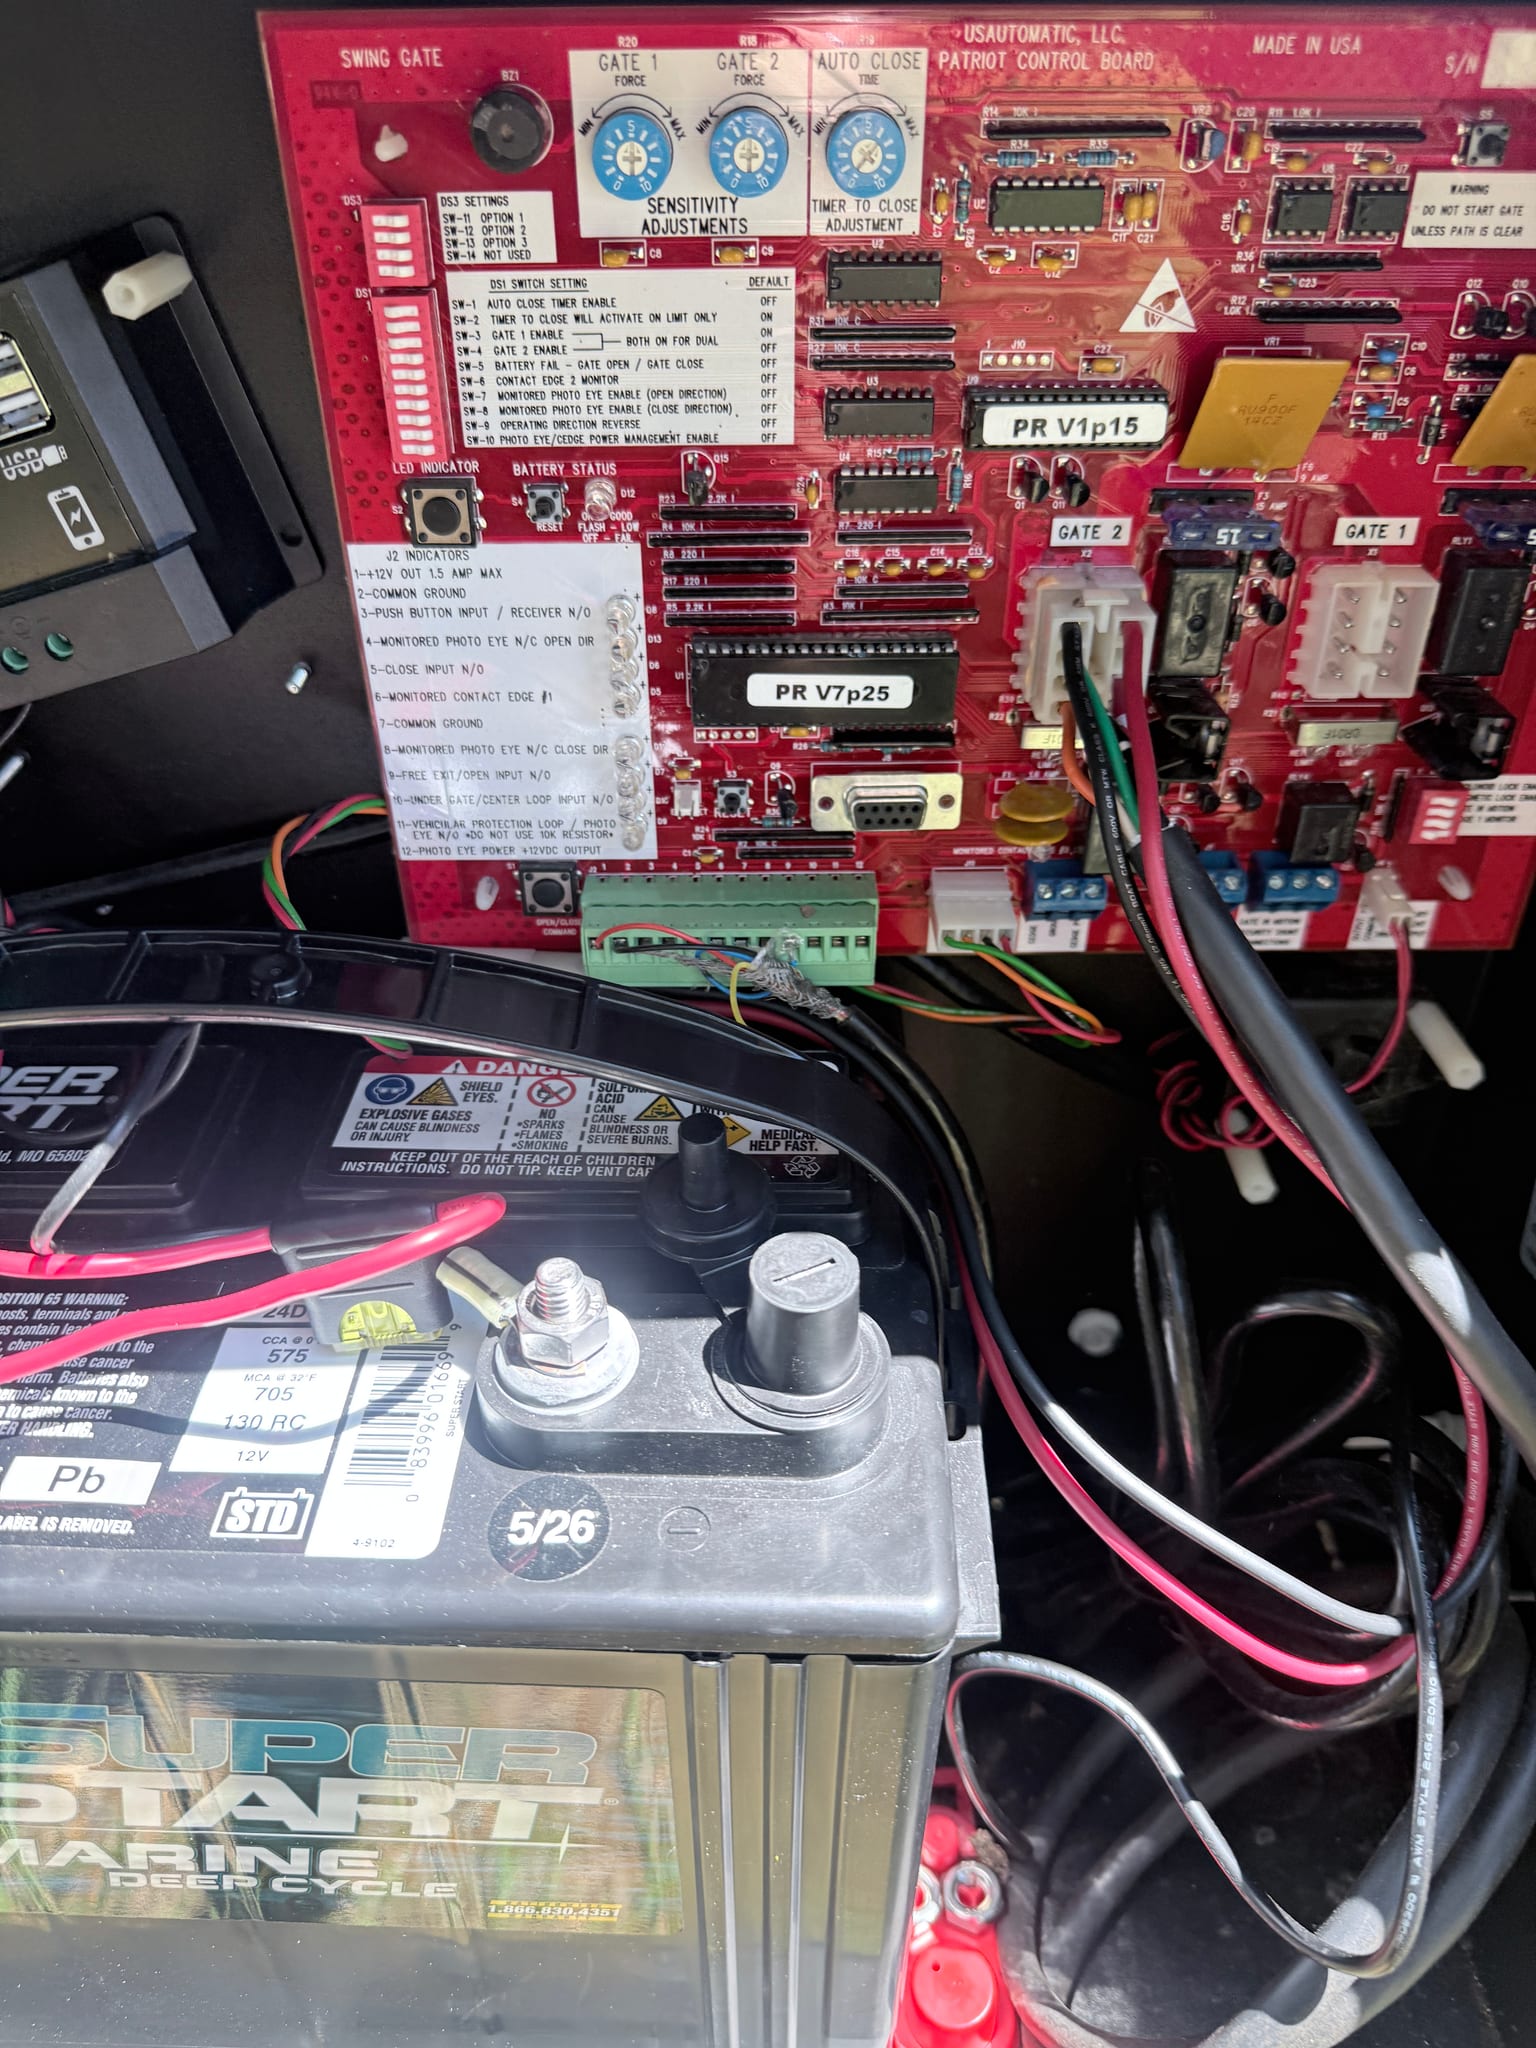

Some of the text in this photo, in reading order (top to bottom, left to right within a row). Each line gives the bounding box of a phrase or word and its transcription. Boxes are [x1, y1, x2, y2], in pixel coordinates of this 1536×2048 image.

[964, 24, 1081, 45] USAUTOMATIC,
[1253, 36, 1361, 55] MADE IN USA
[340, 49, 443, 68] SWING GATE
[599, 53, 659, 71] GATE 1
[717, 52, 778, 71] GATE 2
[817, 52, 922, 70] AUTO CLOSE
[939, 52, 1154, 70] PATRIOT CONTROL BOARD
[1444, 55, 1480, 78] S/N
[615, 75, 646, 87] FORCE
[734, 74, 765, 86] FORCE
[858, 74, 879, 86] TIME
[1450, 184, 1489, 195] WARNING
[441, 196, 509, 207] DS3 SETTINGS
[647, 197, 739, 214] SENSITIVITY
[812, 199, 918, 213] TIMER TO CLOSE
[1422, 205, 1523, 216] DO NOT START GATE
[443, 213, 524, 223] SW-11 OPTION 1
[444, 226, 527, 236] SW-12 OPTION 2
[641, 218, 748, 235] ADJUSTMENTS
[825, 218, 904, 232] ADJUSTMENT
[1411, 226, 1523, 237] UNLESS PATH IS CLEAR
[445, 238, 528, 249] SW-13 OPTION 3
[447, 250, 532, 261] SW-14 NOT USED
[490, 276, 789, 289] DS1 SWITCH SETTING DEFAULT
[452, 296, 777, 309] SW-1 AUTO CLOSE TIMER ENABLE OFF
[454, 312, 773, 325] SW-2 TIMER TO CLOSE WILL ACTIVATE ON LIMIT ONLY ON
[455, 331, 481, 341] SW-3
[492, 330, 515, 340] GATE
[530, 330, 564, 340] ENABLE
[760, 328, 773, 337] ON
[626, 336, 719, 346] BOTH ON FOR DUAL
[457, 343, 777, 356] SW-4 GATE 2 ENABLE OFF
[1013, 416, 1139, 441] PR V1p15
[393, 460, 480, 474] LED INDICATOR
[512, 463, 617, 476] BATTERY STATUS
[536, 522, 563, 532] RESET
[1058, 525, 1122, 540] GATE 2
[1346, 523, 1406, 539] GATE 1
[386, 550, 470, 562] J2 INDICATORS
[401, 569, 422, 579] OUT
[430, 568, 444, 579] 1.5
[452, 568, 473, 579] AMP
[480, 568, 503, 579] MAX
[358, 588, 466, 600] 2-COMMON GROUND
[370, 664, 419, 675] 5-CLOSE
[426, 664, 454, 675] INPUT
[776, 684, 890, 704] PR V7p25
[460, 1081, 503, 1103] SHIELD EYES.
[359, 1108, 472, 1121] EXPLOSIVE GASES
[538, 1109, 556, 1119] NO
[354, 1121, 480, 1133] CAN CAUSE BLINDNESS
[351, 1132, 410, 1142] OR INJURY.
[17, 1151, 42, 1162] MO
[390, 1151, 656, 1166] KEEP OUT OF THE REACH OF CHILDREN
[266, 1348, 309, 1363] 575
[254, 1387, 295, 1401] 705
[224, 1414, 306, 1430] 130 RC
[237, 1450, 270, 1462] 12V
[47, 1465, 106, 1494] Pb
[225, 1499, 298, 1533] STD
[40, 1516, 136, 1535] IS REMOVED.
[508, 1509, 596, 1547] 5/26
[0, 1702, 598, 1785] SUPER
[107, 1871, 458, 1898] DEEP CYCLE
[487, 1904, 621, 1917] 1.866.830.4351
